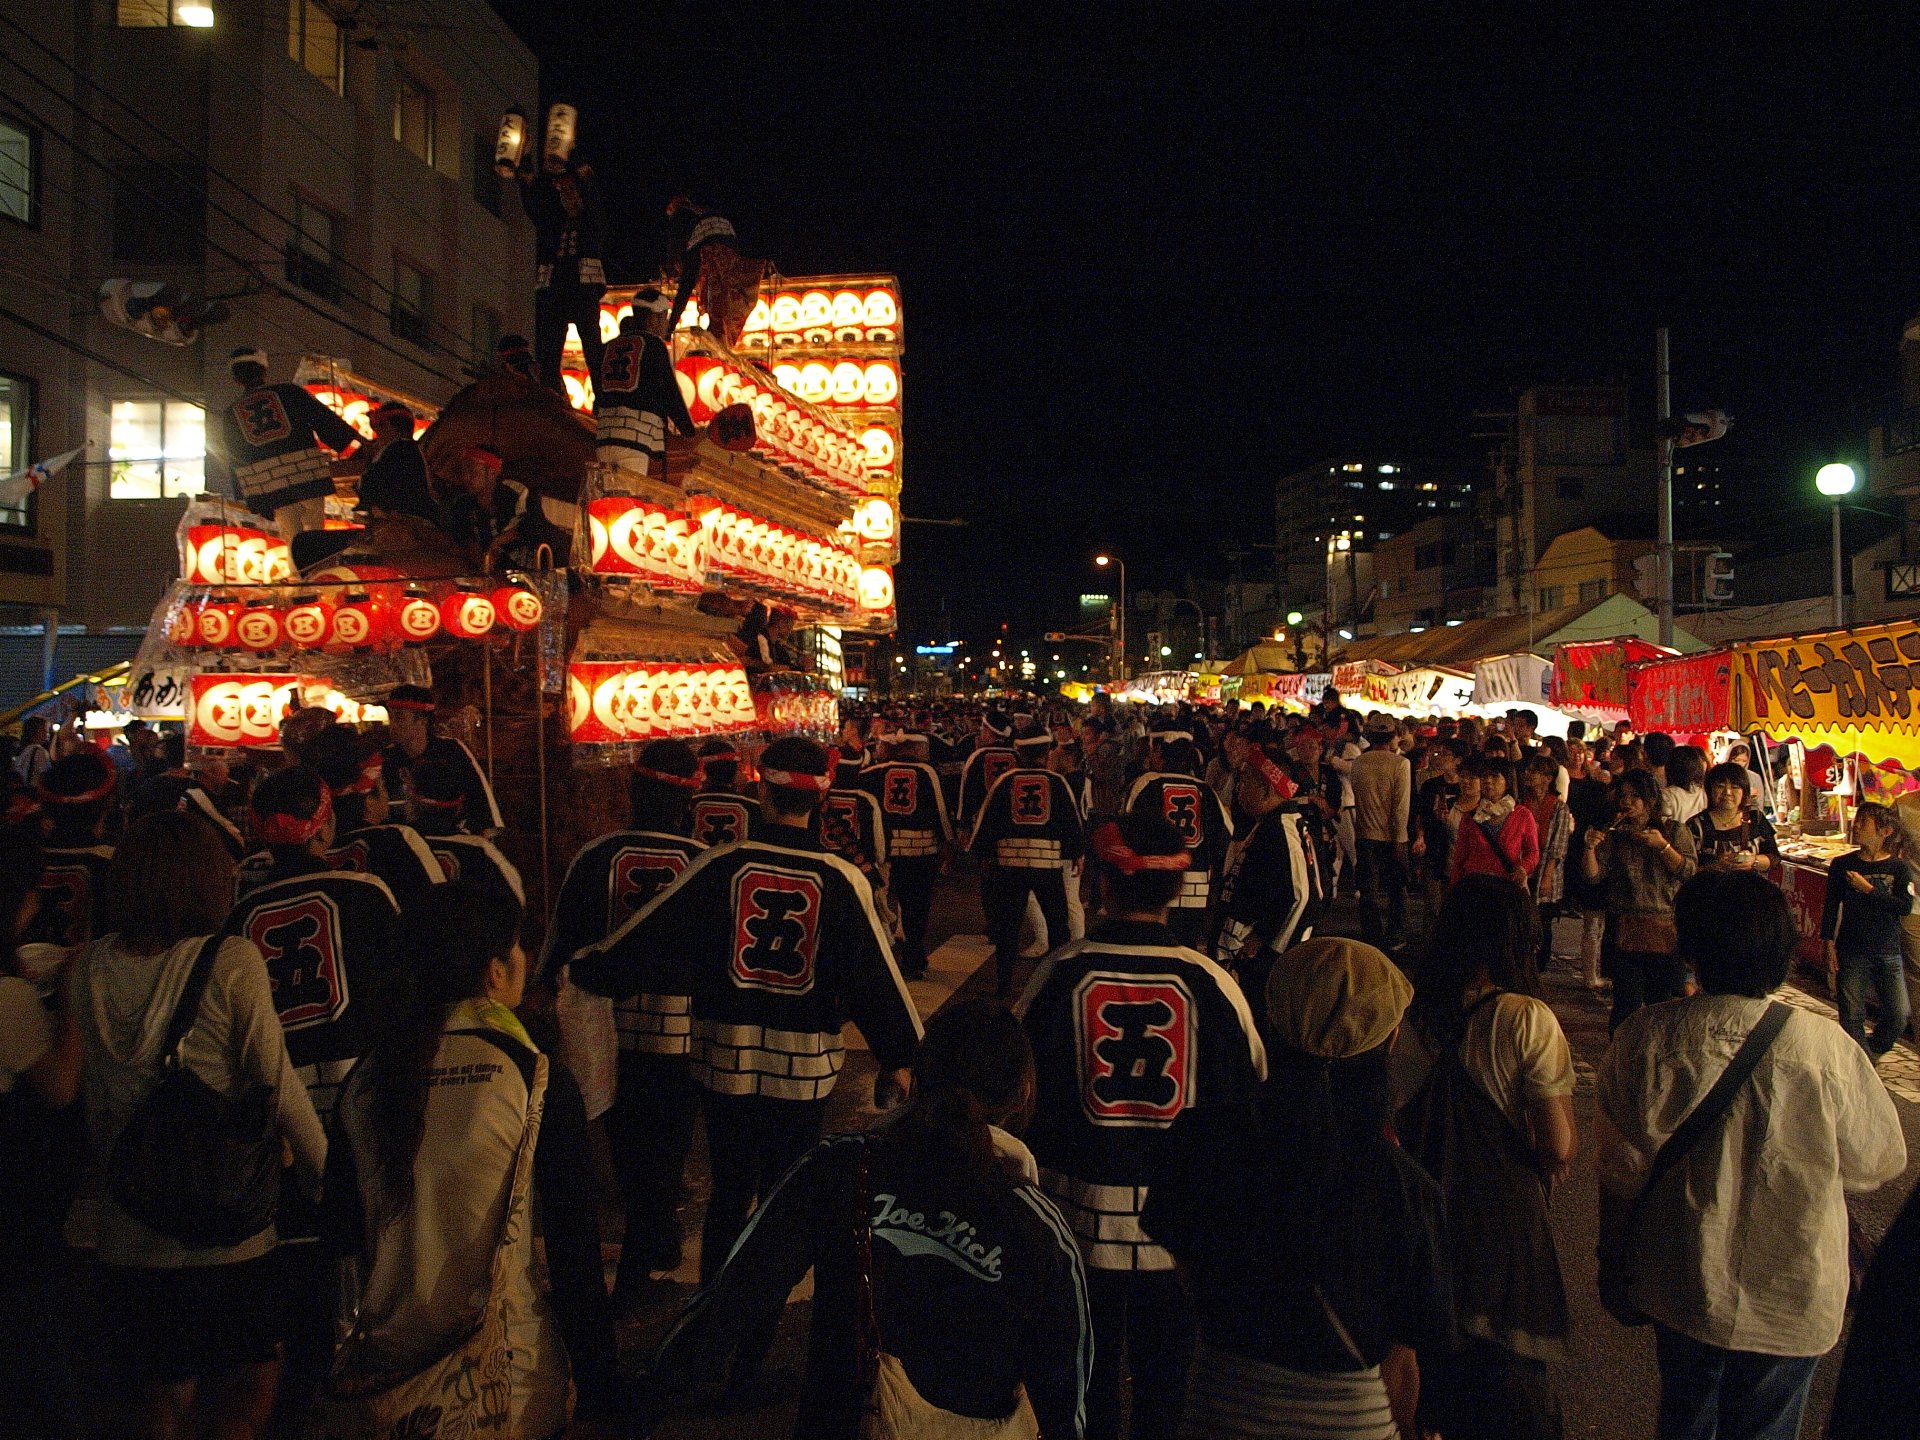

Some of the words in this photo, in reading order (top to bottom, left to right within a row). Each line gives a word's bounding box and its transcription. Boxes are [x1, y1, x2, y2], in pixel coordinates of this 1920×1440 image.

[891, 774, 912, 804] 五
[1017, 783, 1042, 817] 五
[1168, 794, 1197, 838] 五
[262, 914, 332, 1015] 五
[739, 887, 812, 980] 五
[1092, 999, 1182, 1106] 五
